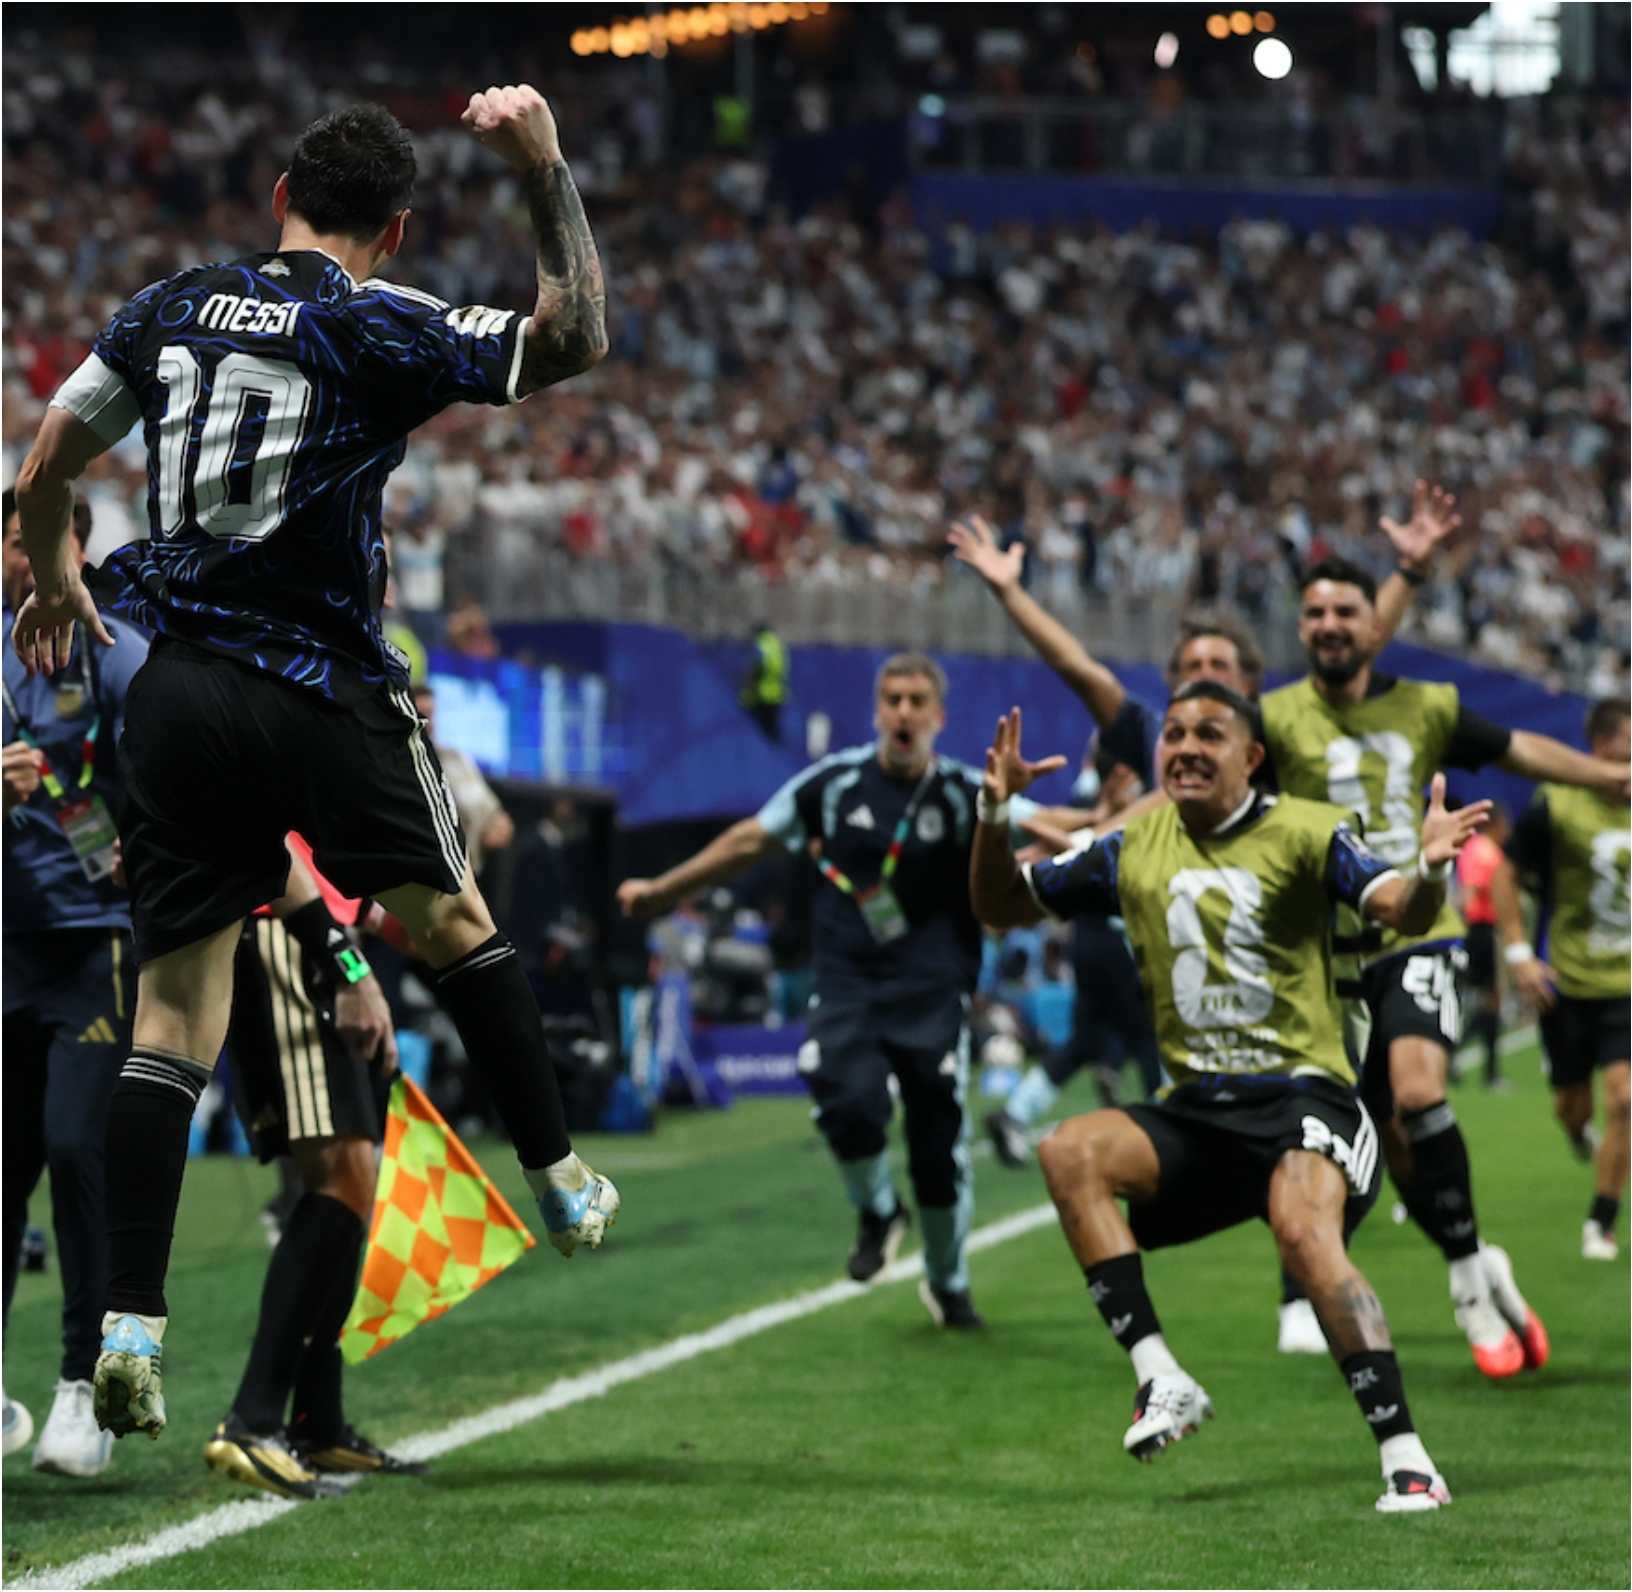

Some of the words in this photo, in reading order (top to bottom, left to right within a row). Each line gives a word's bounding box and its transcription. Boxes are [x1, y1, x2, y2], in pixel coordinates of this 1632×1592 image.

[197, 292, 305, 339] MESSI
[156, 344, 312, 543] 10
[1200, 991, 1245, 1012] FIFA
